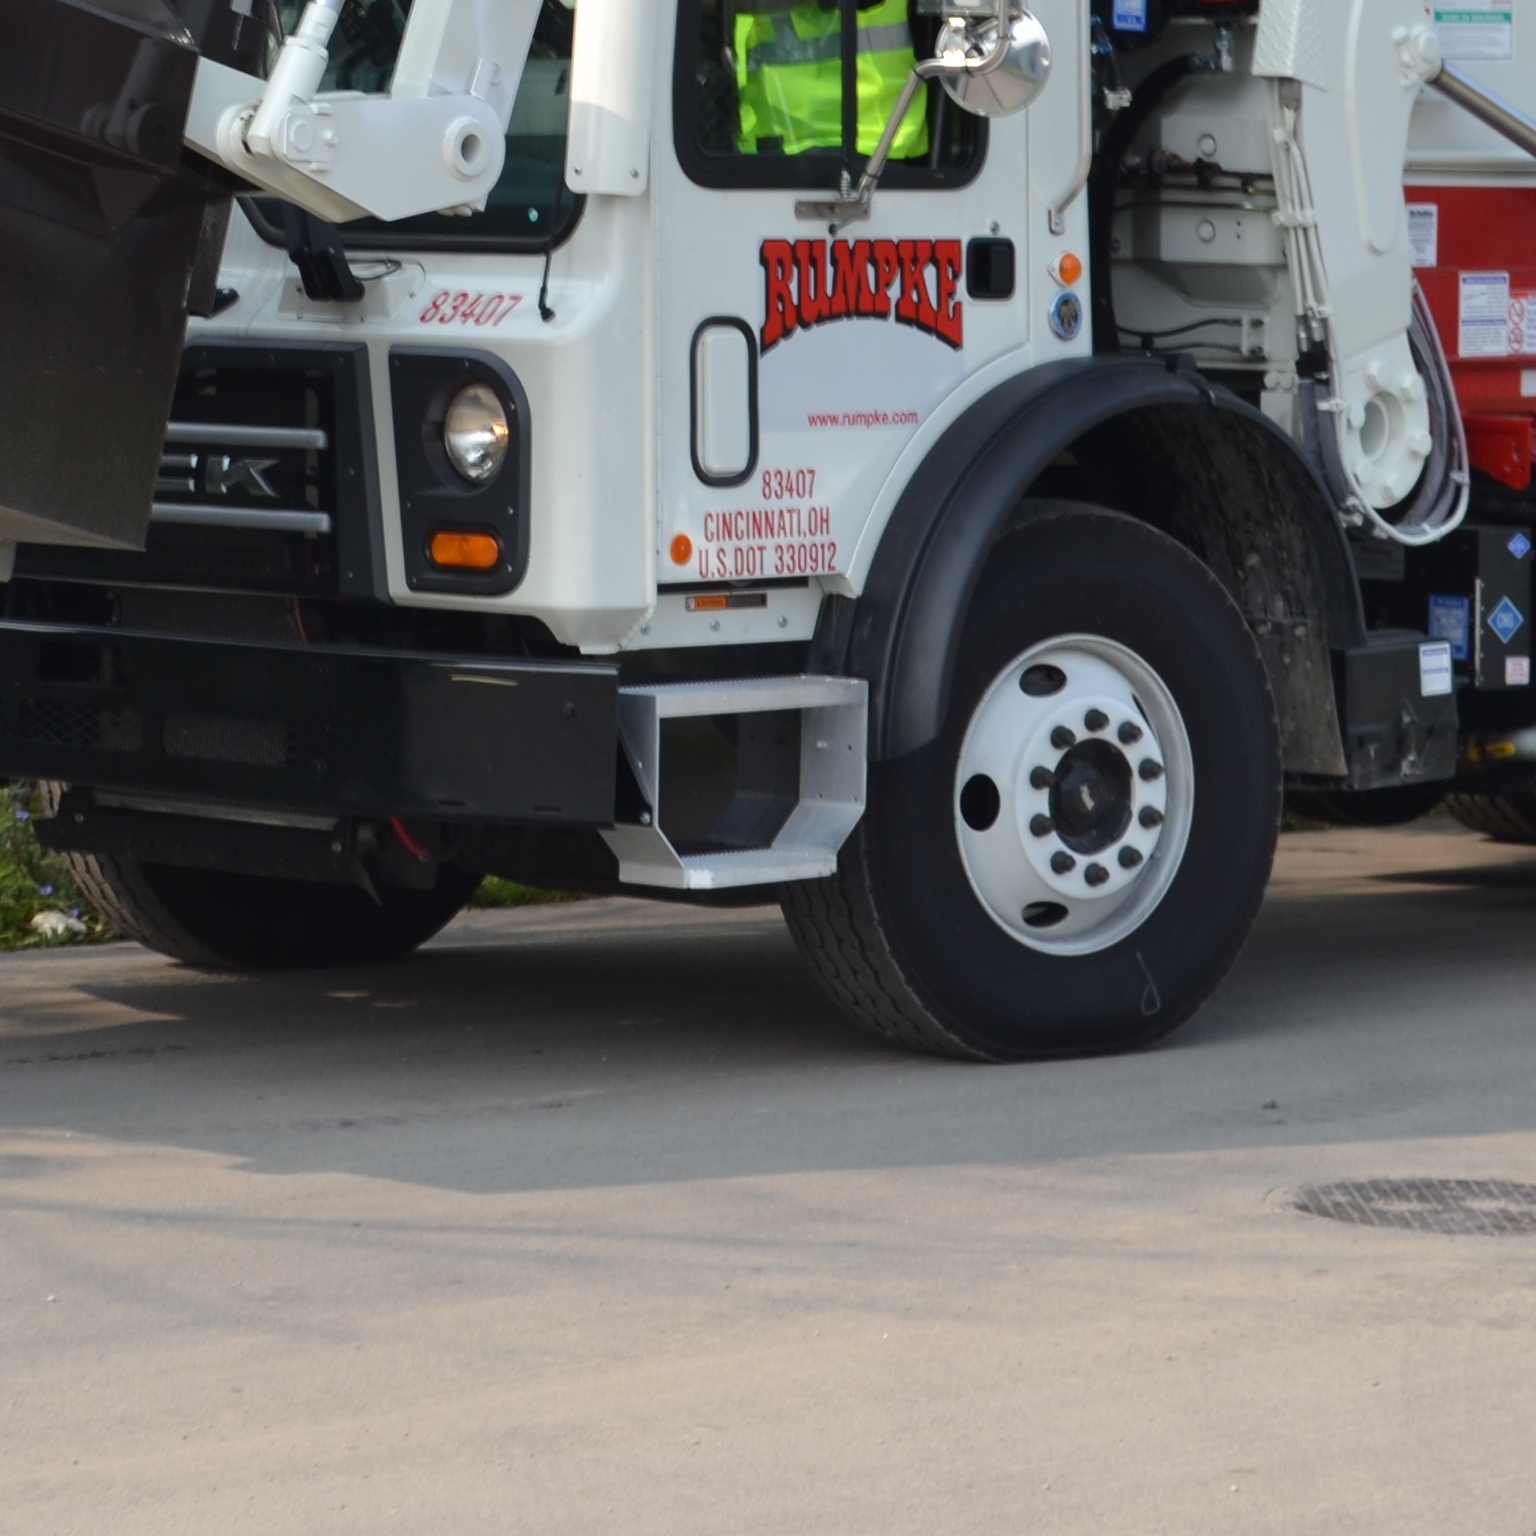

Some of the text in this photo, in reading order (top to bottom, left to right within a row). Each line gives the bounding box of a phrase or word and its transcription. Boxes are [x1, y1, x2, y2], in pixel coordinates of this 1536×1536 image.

[419, 289, 524, 327] 83407
[759, 238, 963, 360] RUMPKE
[807, 410, 919, 428] www.rumpke.com
[762, 468, 816, 501] 83407
[774, 541, 837, 575] 330912
